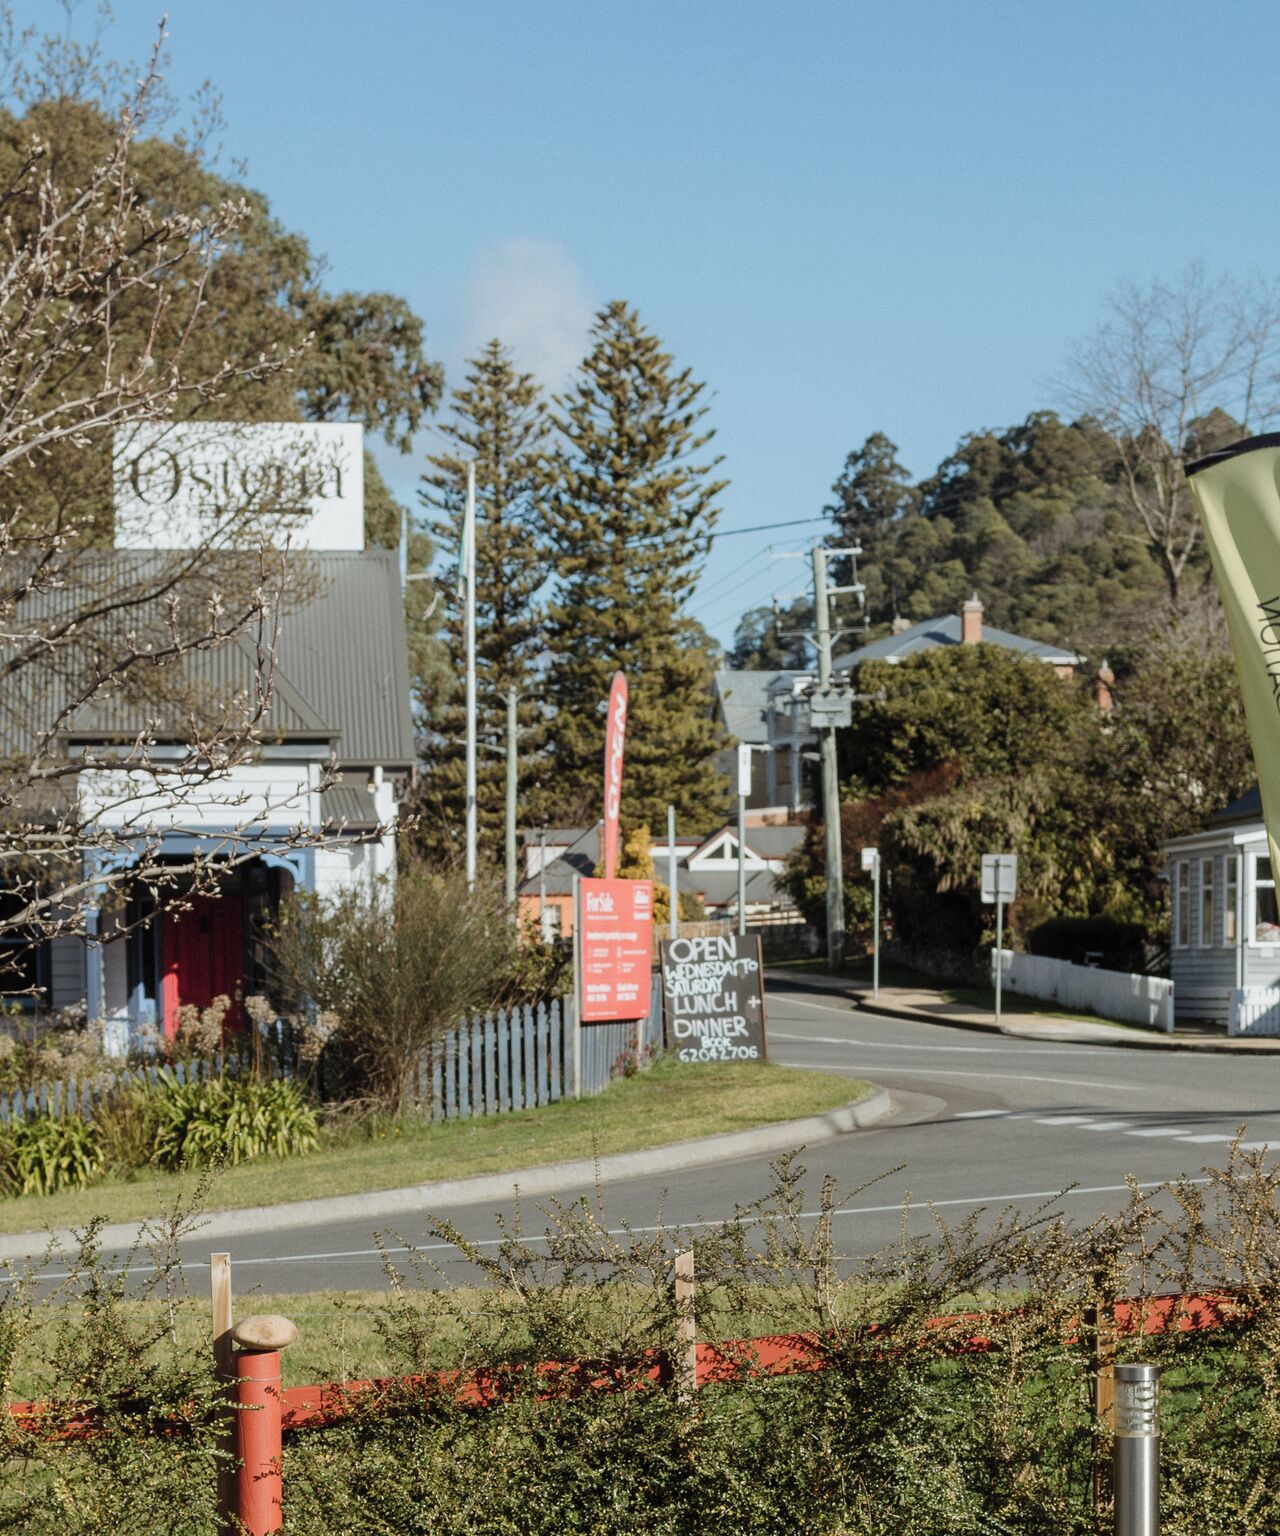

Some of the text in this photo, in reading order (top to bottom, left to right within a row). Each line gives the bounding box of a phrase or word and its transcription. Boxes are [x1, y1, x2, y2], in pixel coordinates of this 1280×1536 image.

[607, 692, 626, 822] OPEN
[586, 892, 600, 912] For
[600, 892, 613, 912] Sale
[669, 933, 737, 963] OPEN
[664, 960, 738, 980] WEDNESDAY
[666, 977, 724, 998] SATURDAY
[673, 992, 738, 1016] LUNCH
[673, 1016, 750, 1038] DINNER
[679, 1046, 759, 1063] 62042706
